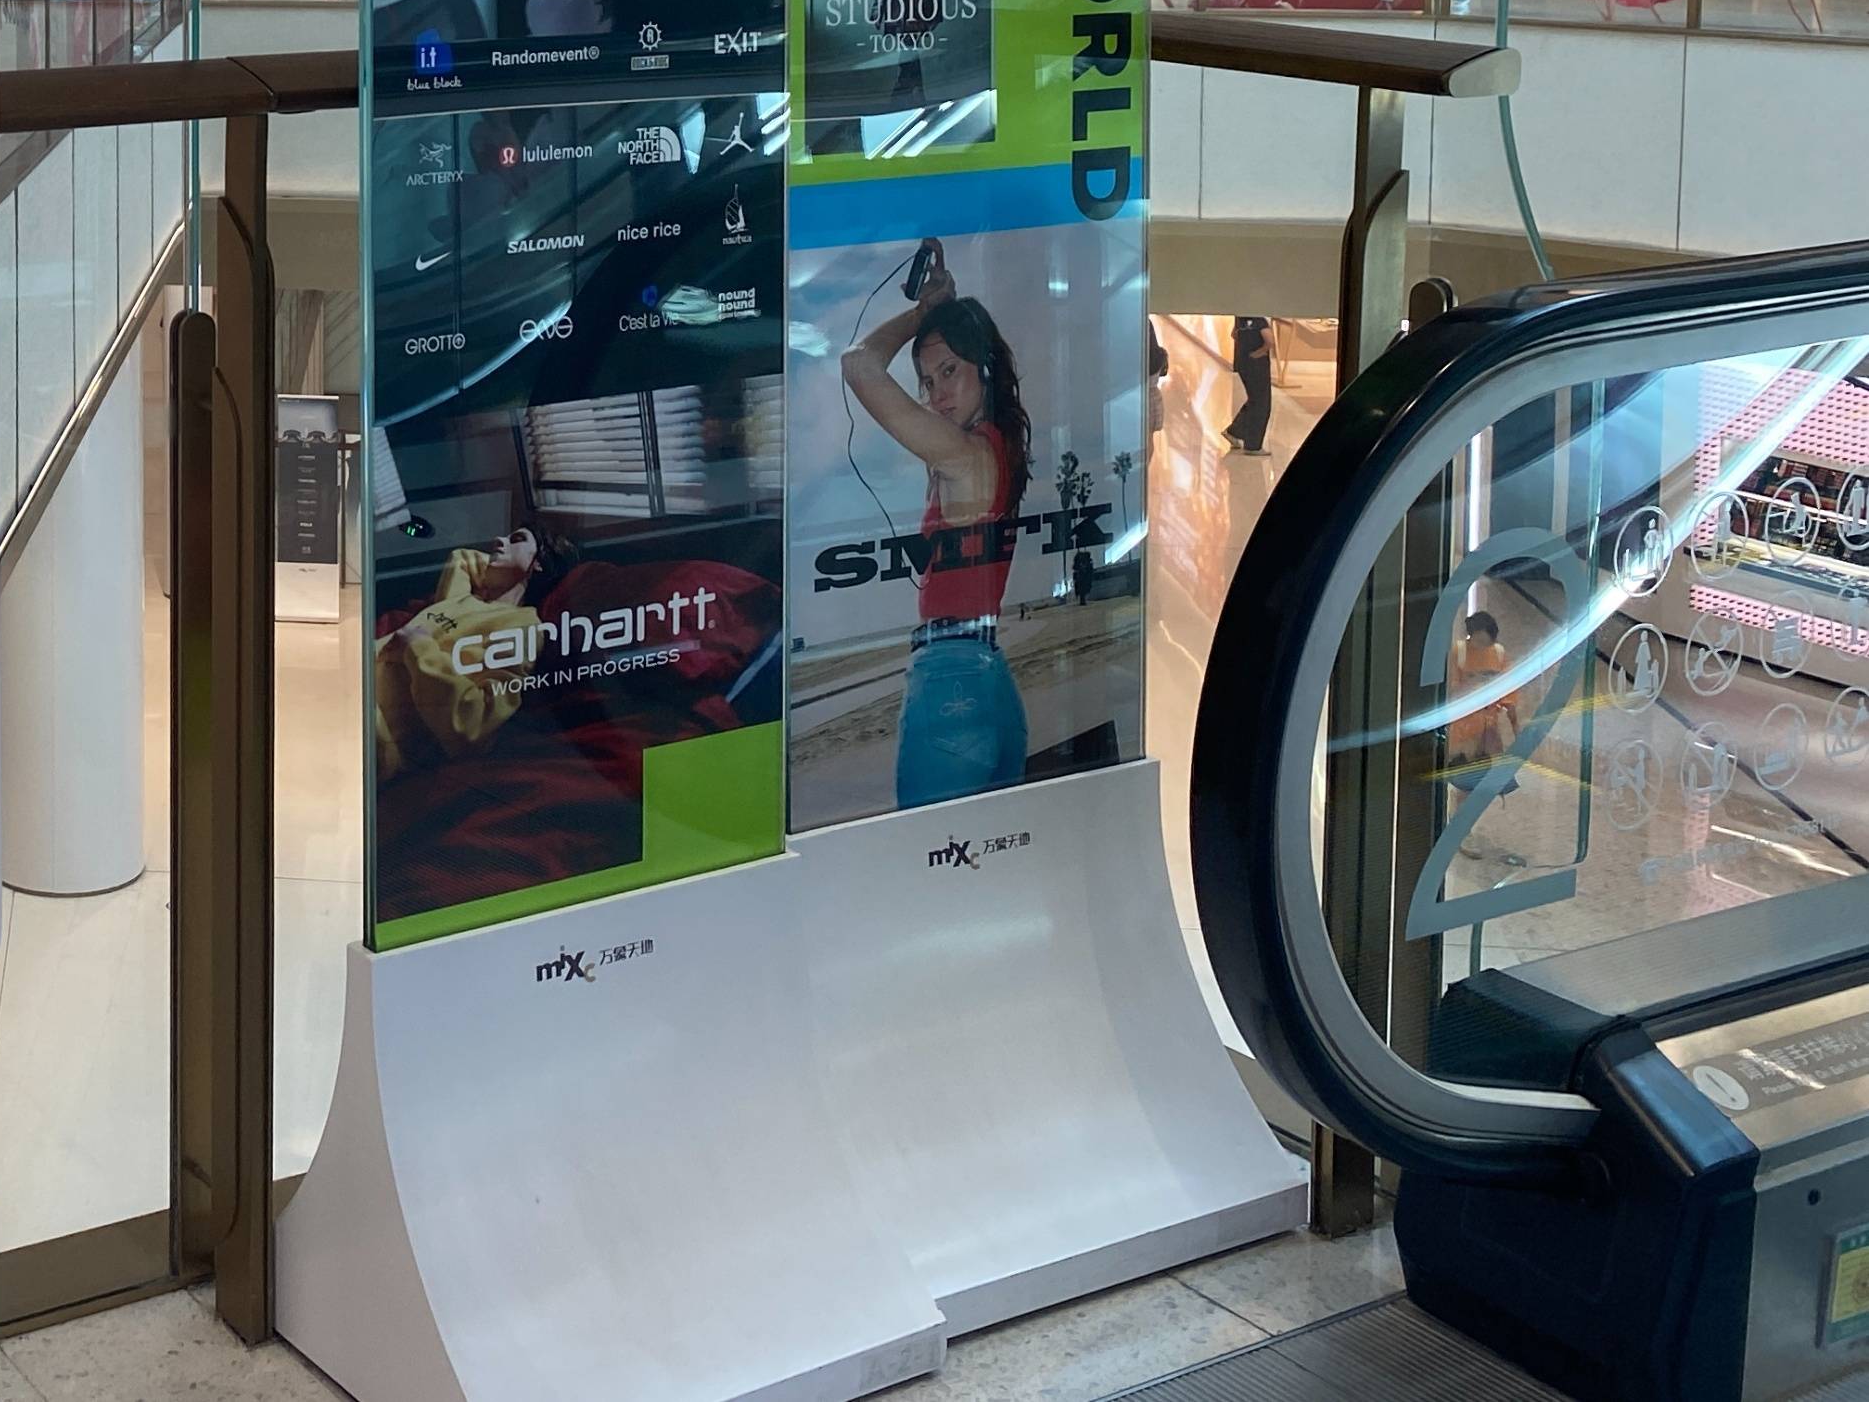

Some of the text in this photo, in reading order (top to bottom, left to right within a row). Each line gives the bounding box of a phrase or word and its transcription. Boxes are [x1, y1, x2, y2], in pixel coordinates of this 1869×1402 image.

[407, 75, 464, 91] blue block
[636, 126, 660, 140] THE
[522, 144, 594, 164] lululemon
[617, 139, 659, 155] NORTH
[630, 152, 660, 166] FACE
[617, 221, 682, 242] nice rice
[507, 235, 585, 255] SALOMON
[718, 287, 756, 302] nound
[718, 298, 756, 312] nound
[649, 313, 661, 329] la
[814, 503, 1114, 593] SMFK
[491, 649, 681, 698] WORK IN PROGRESS
[599, 938, 654, 966] 万象天地
